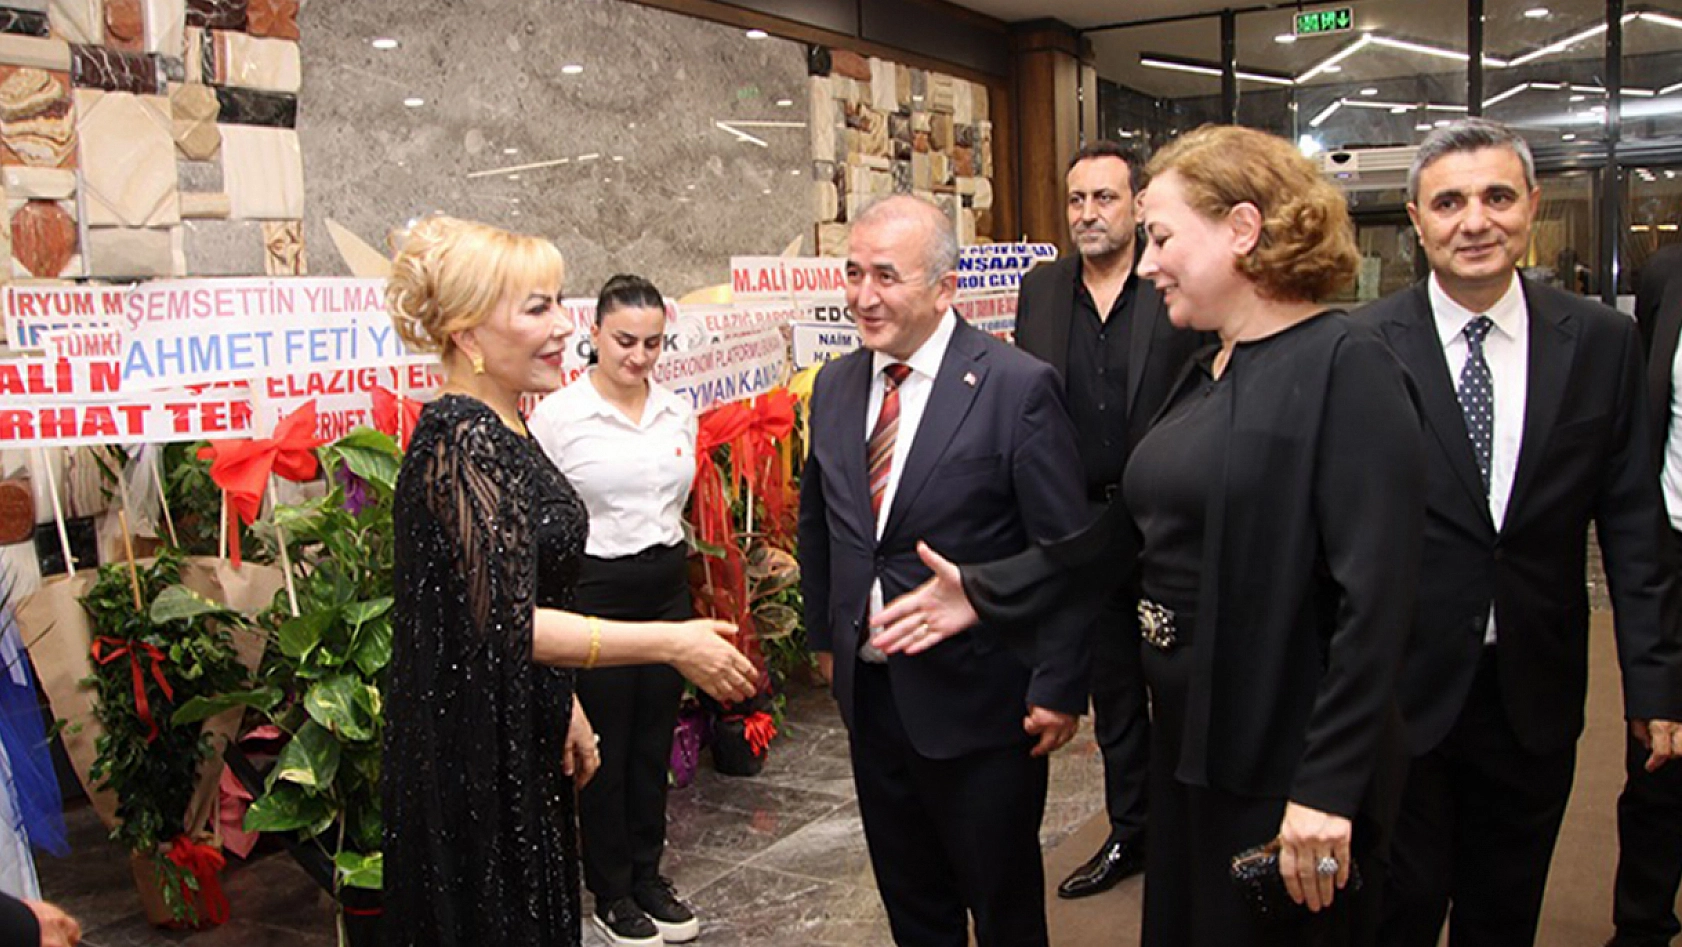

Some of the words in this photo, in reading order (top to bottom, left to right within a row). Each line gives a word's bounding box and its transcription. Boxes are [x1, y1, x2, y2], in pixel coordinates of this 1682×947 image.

[126, 281, 294, 331] ŞEMSETTİN
[123, 332, 272, 379] AHMET
[285, 318, 357, 365] FETİ
